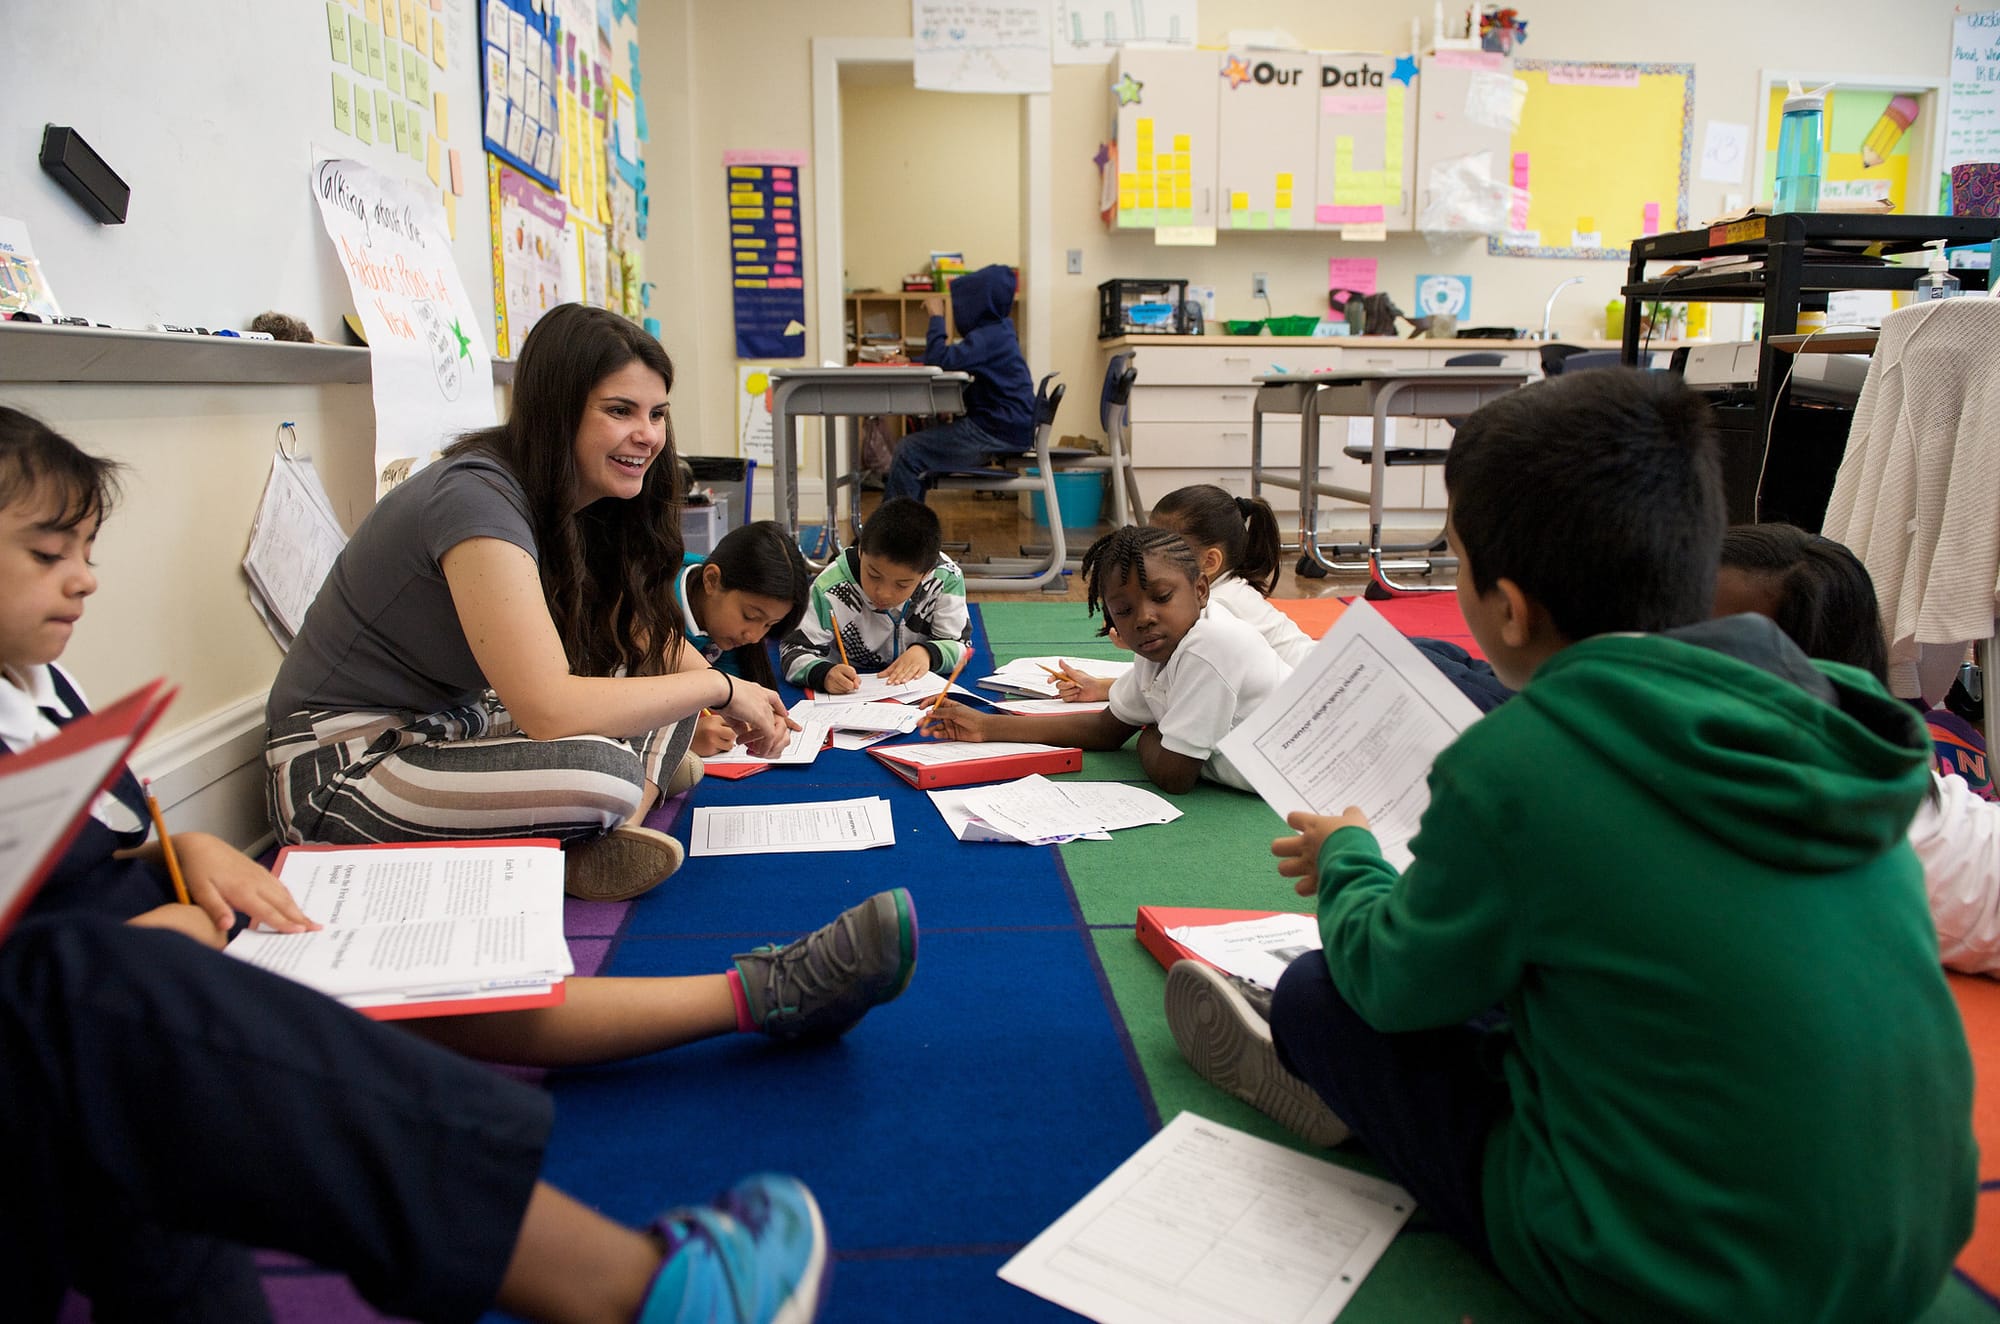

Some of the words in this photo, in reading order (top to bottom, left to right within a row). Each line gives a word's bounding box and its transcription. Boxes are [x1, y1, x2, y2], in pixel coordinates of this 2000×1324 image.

[1253, 62, 1303, 85] Our
[1321, 63, 1383, 88] Data
[319, 159, 372, 248] Talking
[1282, 720, 1312, 750] Inventor
